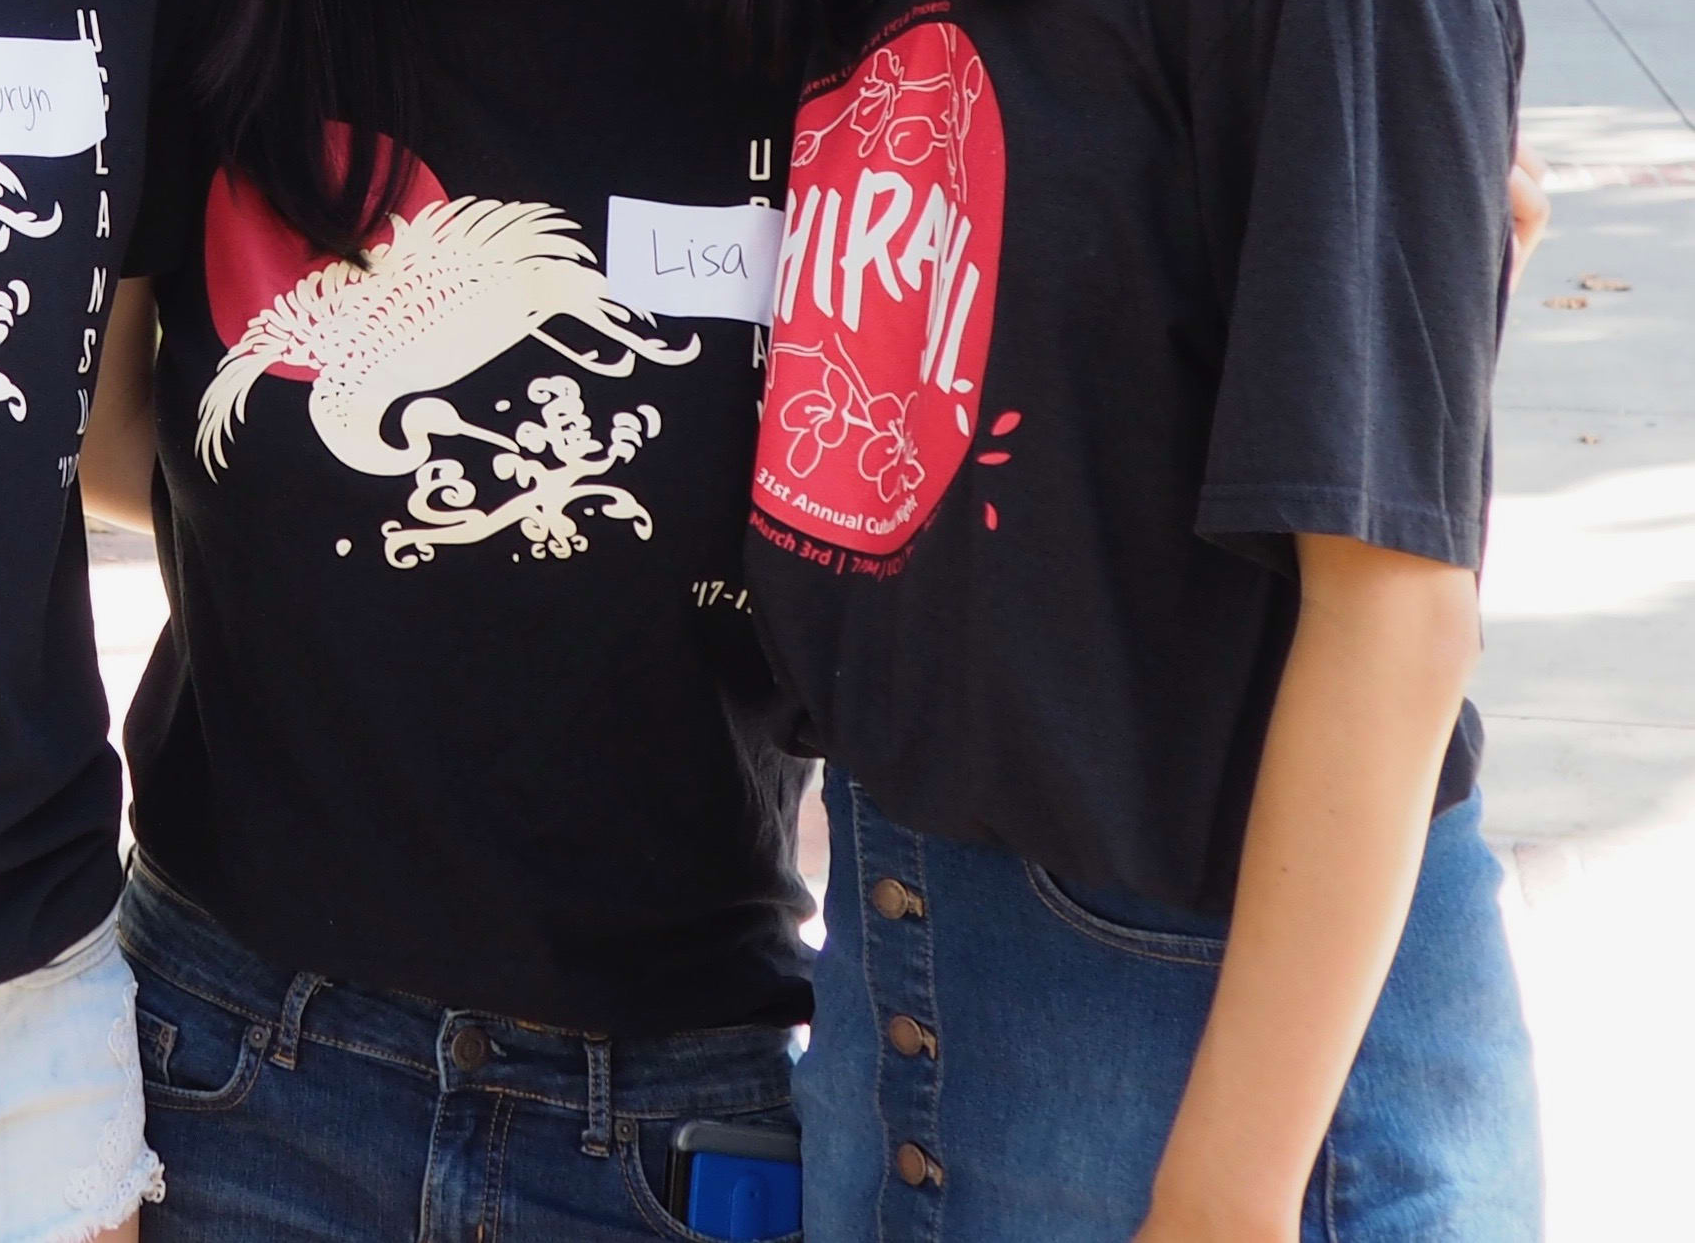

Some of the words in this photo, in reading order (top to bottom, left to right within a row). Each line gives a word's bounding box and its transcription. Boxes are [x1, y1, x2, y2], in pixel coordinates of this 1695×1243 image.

[652, 228, 749, 280] Lisa
[755, 466, 792, 502] 31st
[791, 493, 864, 531] Annual
[798, 539, 833, 567] 3rd
[691, 580, 753, 614] '17-1
